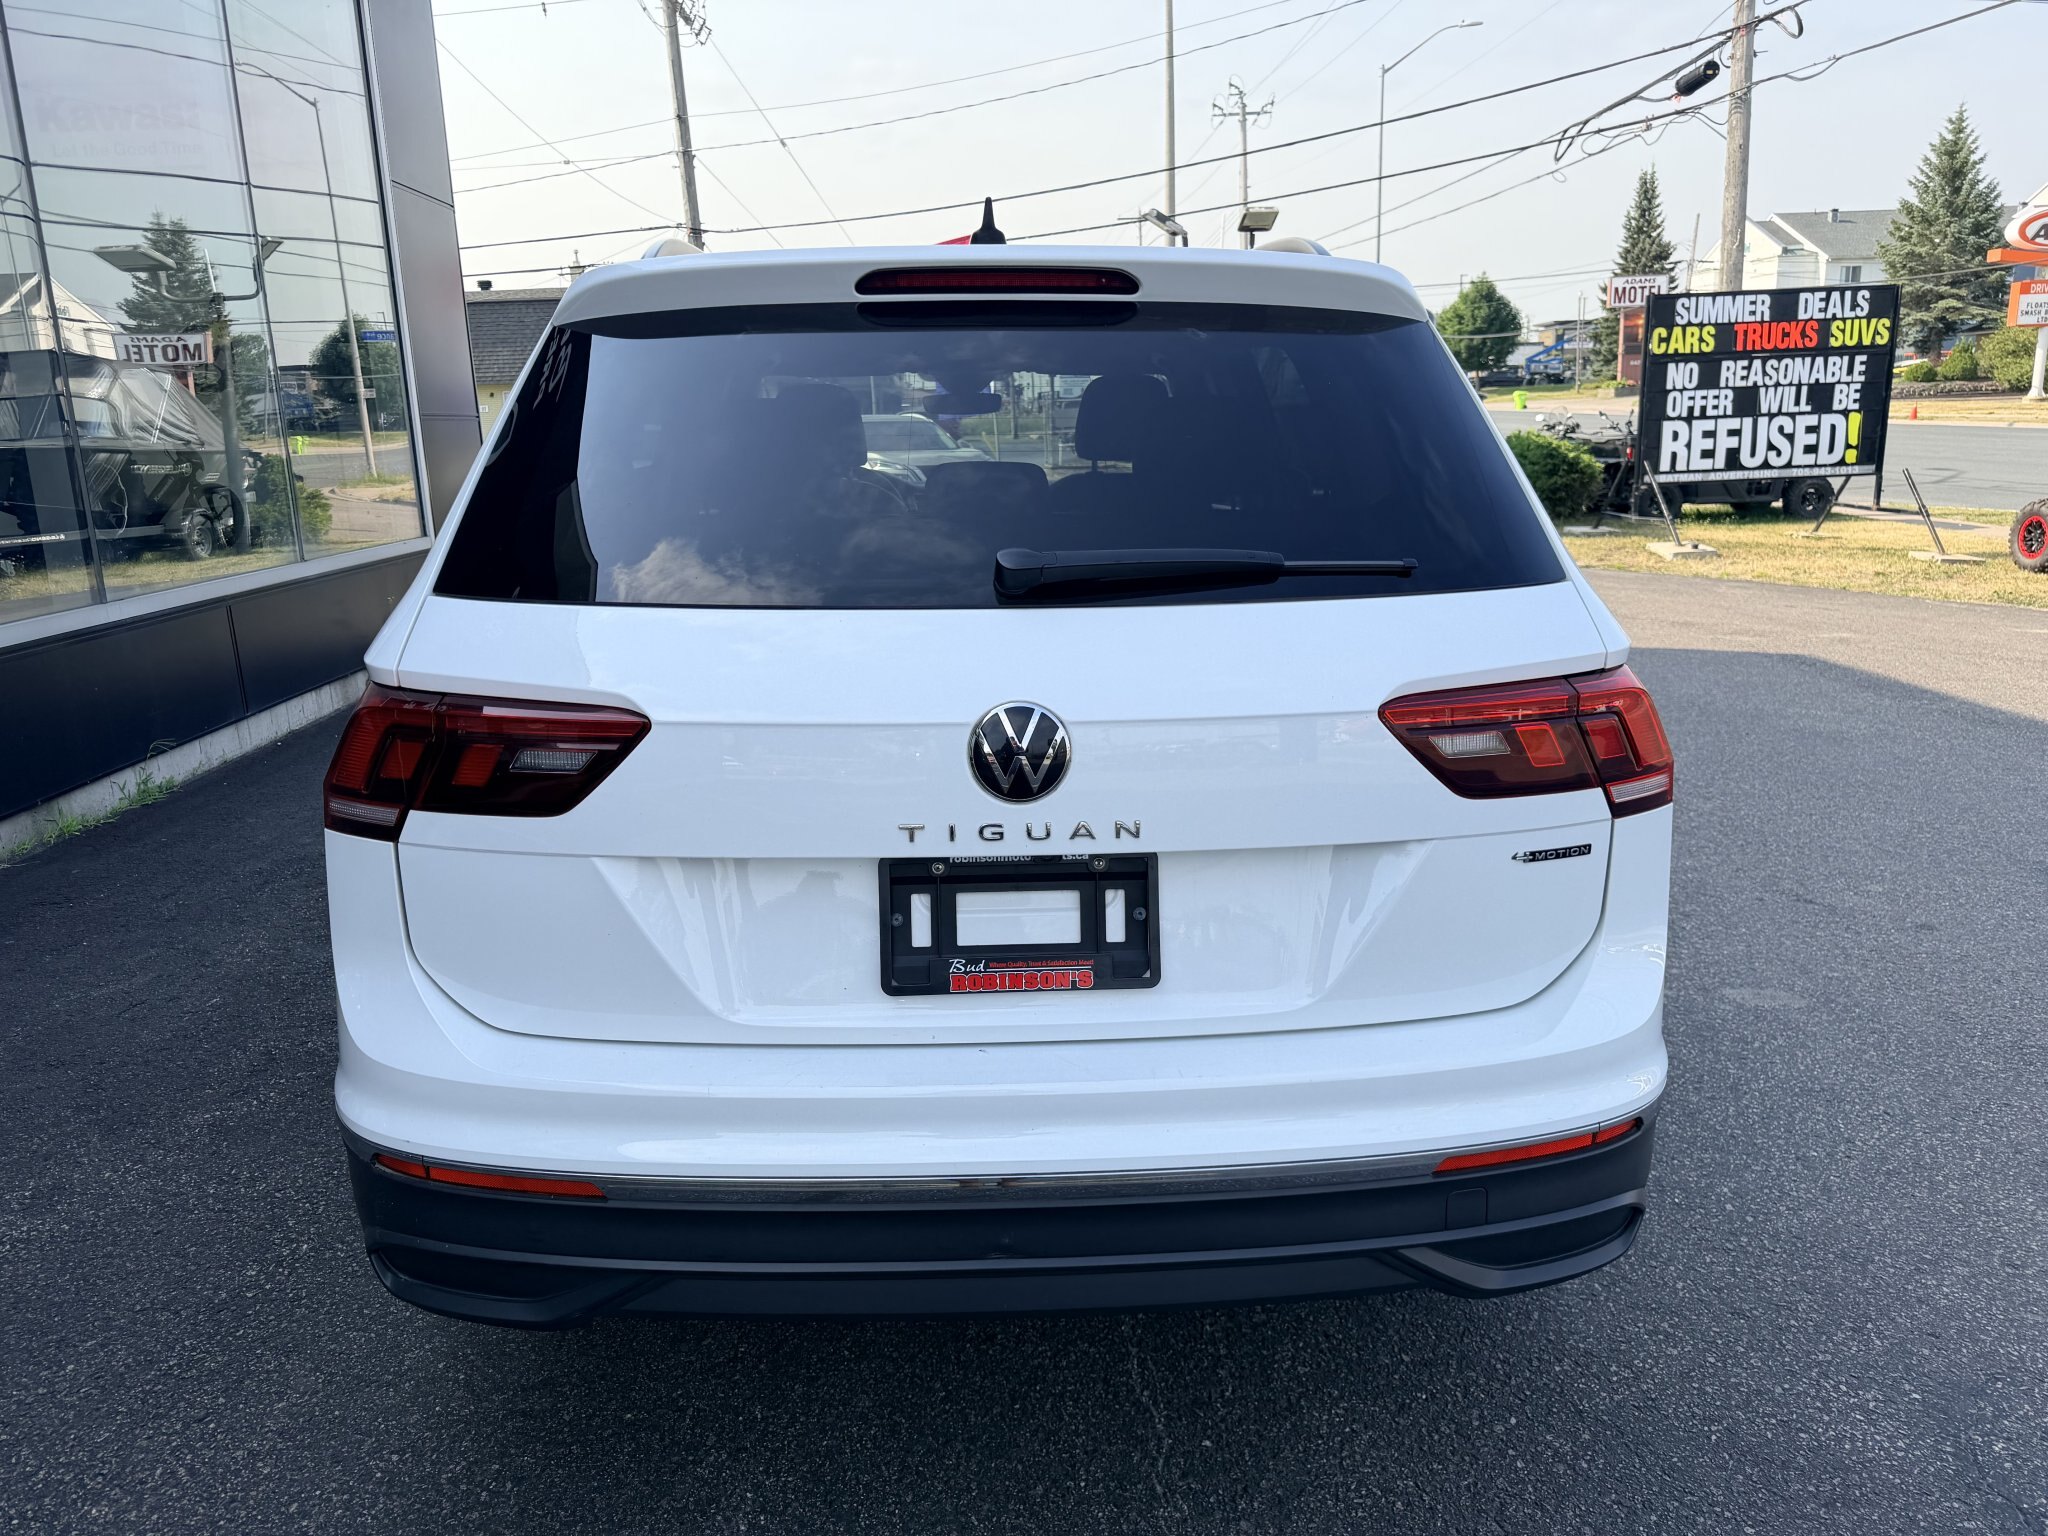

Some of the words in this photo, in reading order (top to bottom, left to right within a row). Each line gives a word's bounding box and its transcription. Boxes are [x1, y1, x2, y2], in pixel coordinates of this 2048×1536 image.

[1675, 294, 1770, 326] SUMMER
[1797, 289, 1871, 320] DEALS
[1652, 325, 1716, 355] CARS
[1733, 320, 1819, 352] TRUCKS
[1829, 317, 1891, 348] SUVS
[1665, 362, 1699, 390] NO
[1719, 354, 1868, 388] REASONABLE
[1666, 388, 1734, 418] OFFER
[1758, 385, 1812, 415] WILL
[1832, 382, 1862, 411] BE
[1659, 411, 1863, 473] REFUSED!
[1659, 473, 1703, 483] BATMAN
[1708, 470, 1779, 481] ADVERTISING
[898, 820, 1141, 843] TIGUAN
[949, 959, 986, 973] Bud
[949, 969, 1094, 992] ROBINSON'S
